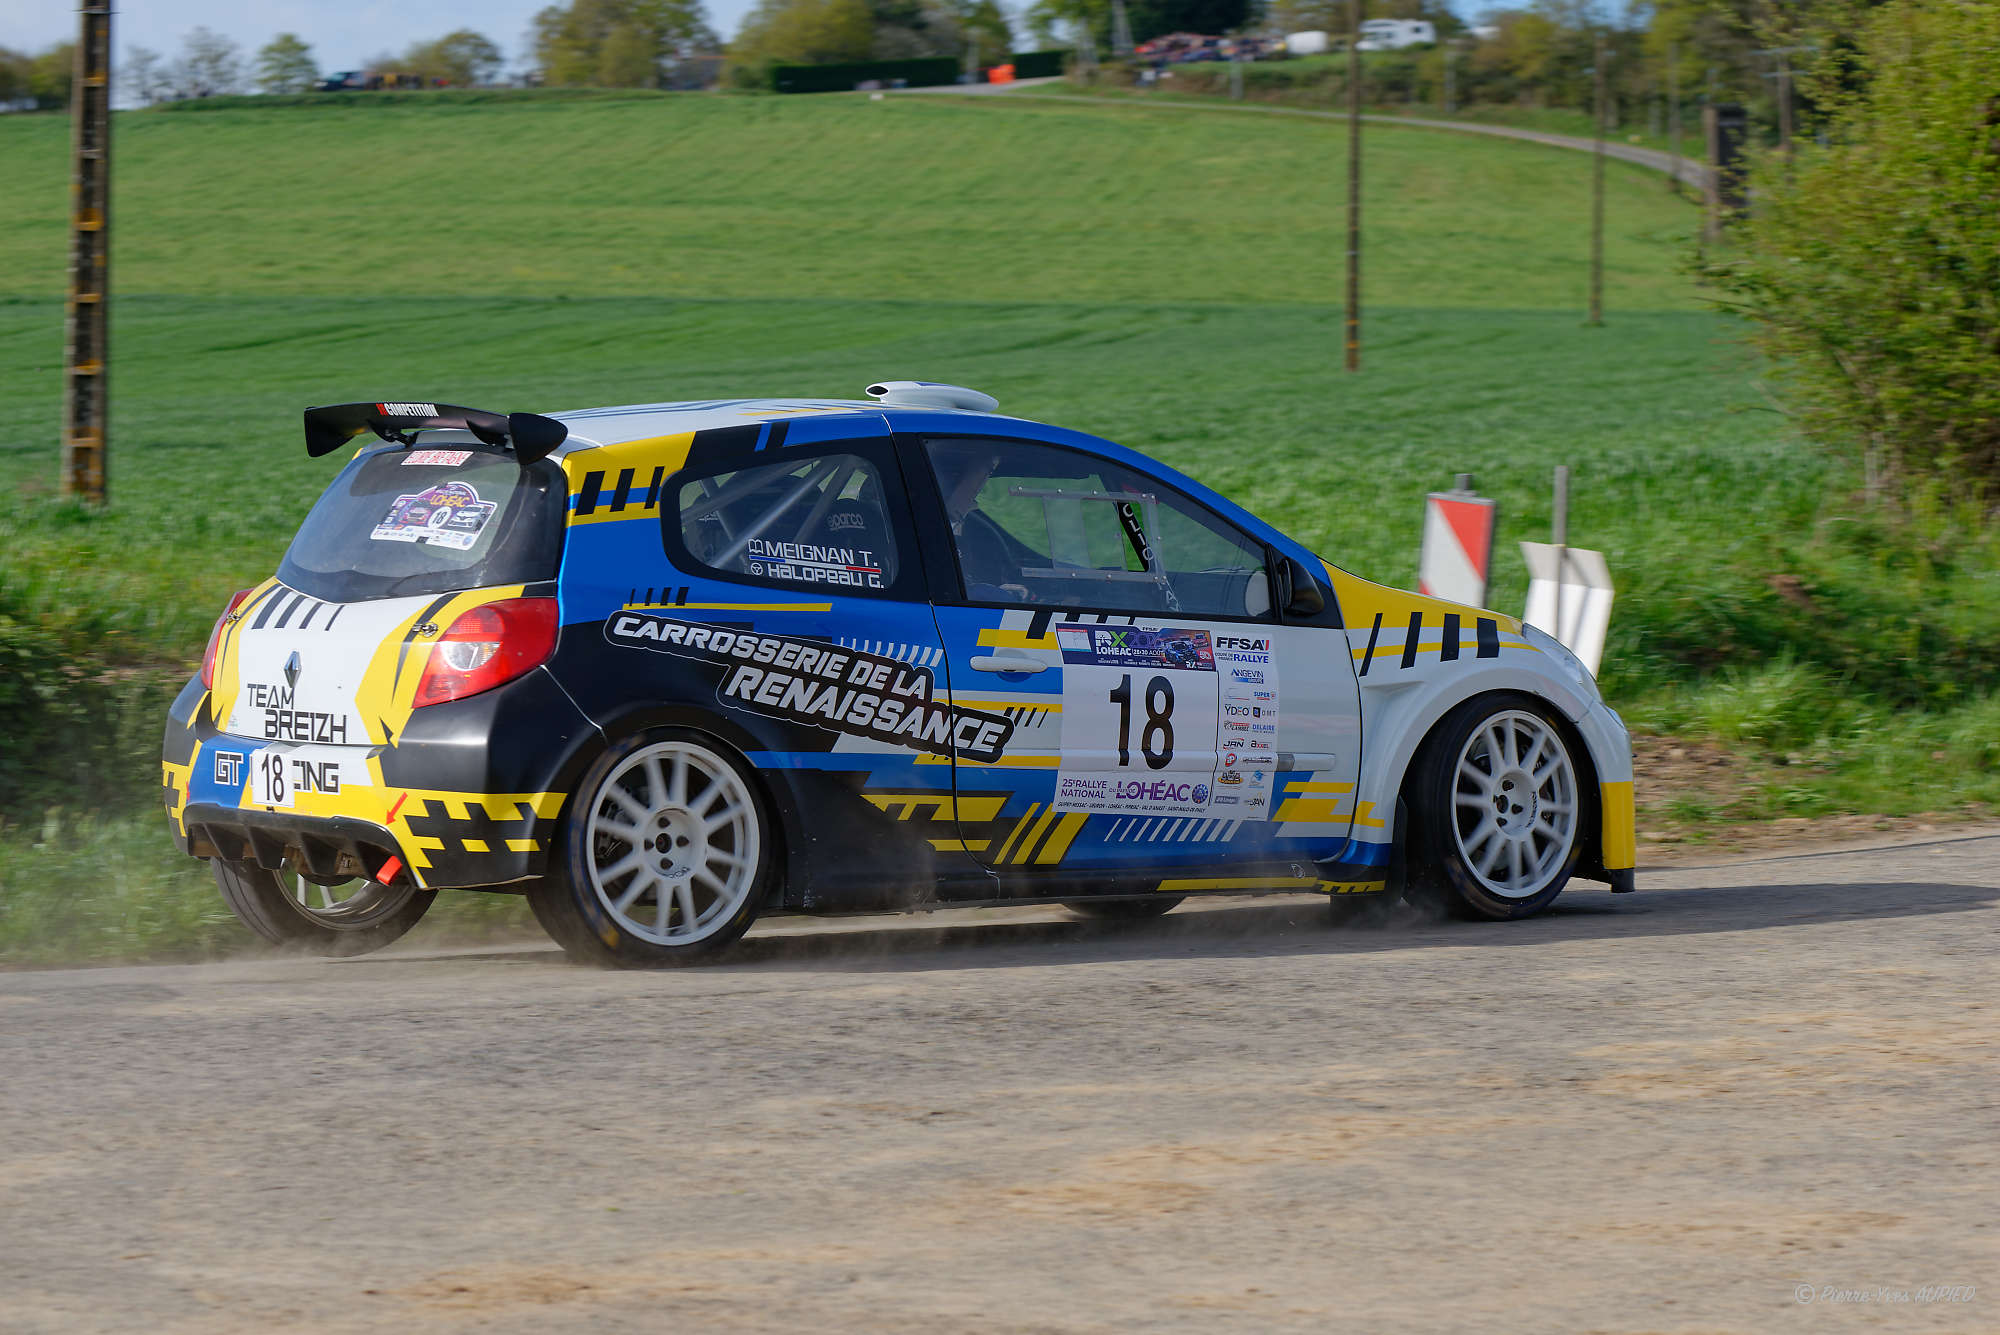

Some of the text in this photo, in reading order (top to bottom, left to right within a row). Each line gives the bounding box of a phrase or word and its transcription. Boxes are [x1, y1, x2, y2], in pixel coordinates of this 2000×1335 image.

[385, 403, 439, 417] COMPETITION
[432, 511, 447, 525] 18
[1122, 503, 1154, 561] CLIO
[765, 540, 878, 567] MEIGNAN T.
[868, 575, 885, 588] G.
[1096, 647, 1132, 656] LOHEAC
[1216, 637, 1264, 651] FFSA
[613, 616, 929, 700] CARROSSERIE DE LA
[1234, 654, 1269, 664] RALLYE
[1231, 668, 1264, 678] ANGEVIN
[247, 683, 295, 710] TEAM
[725, 665, 1006, 754] RENAISSANCE
[265, 709, 347, 744] BREIZH
[1110, 673, 1175, 770] 18
[214, 751, 244, 786] GT
[261, 753, 285, 803] 18
[1061, 789, 1105, 799] NATIONAL
[1075, 779, 1107, 789] RALLYE
[1116, 780, 1190, 802] LOHÉAC
